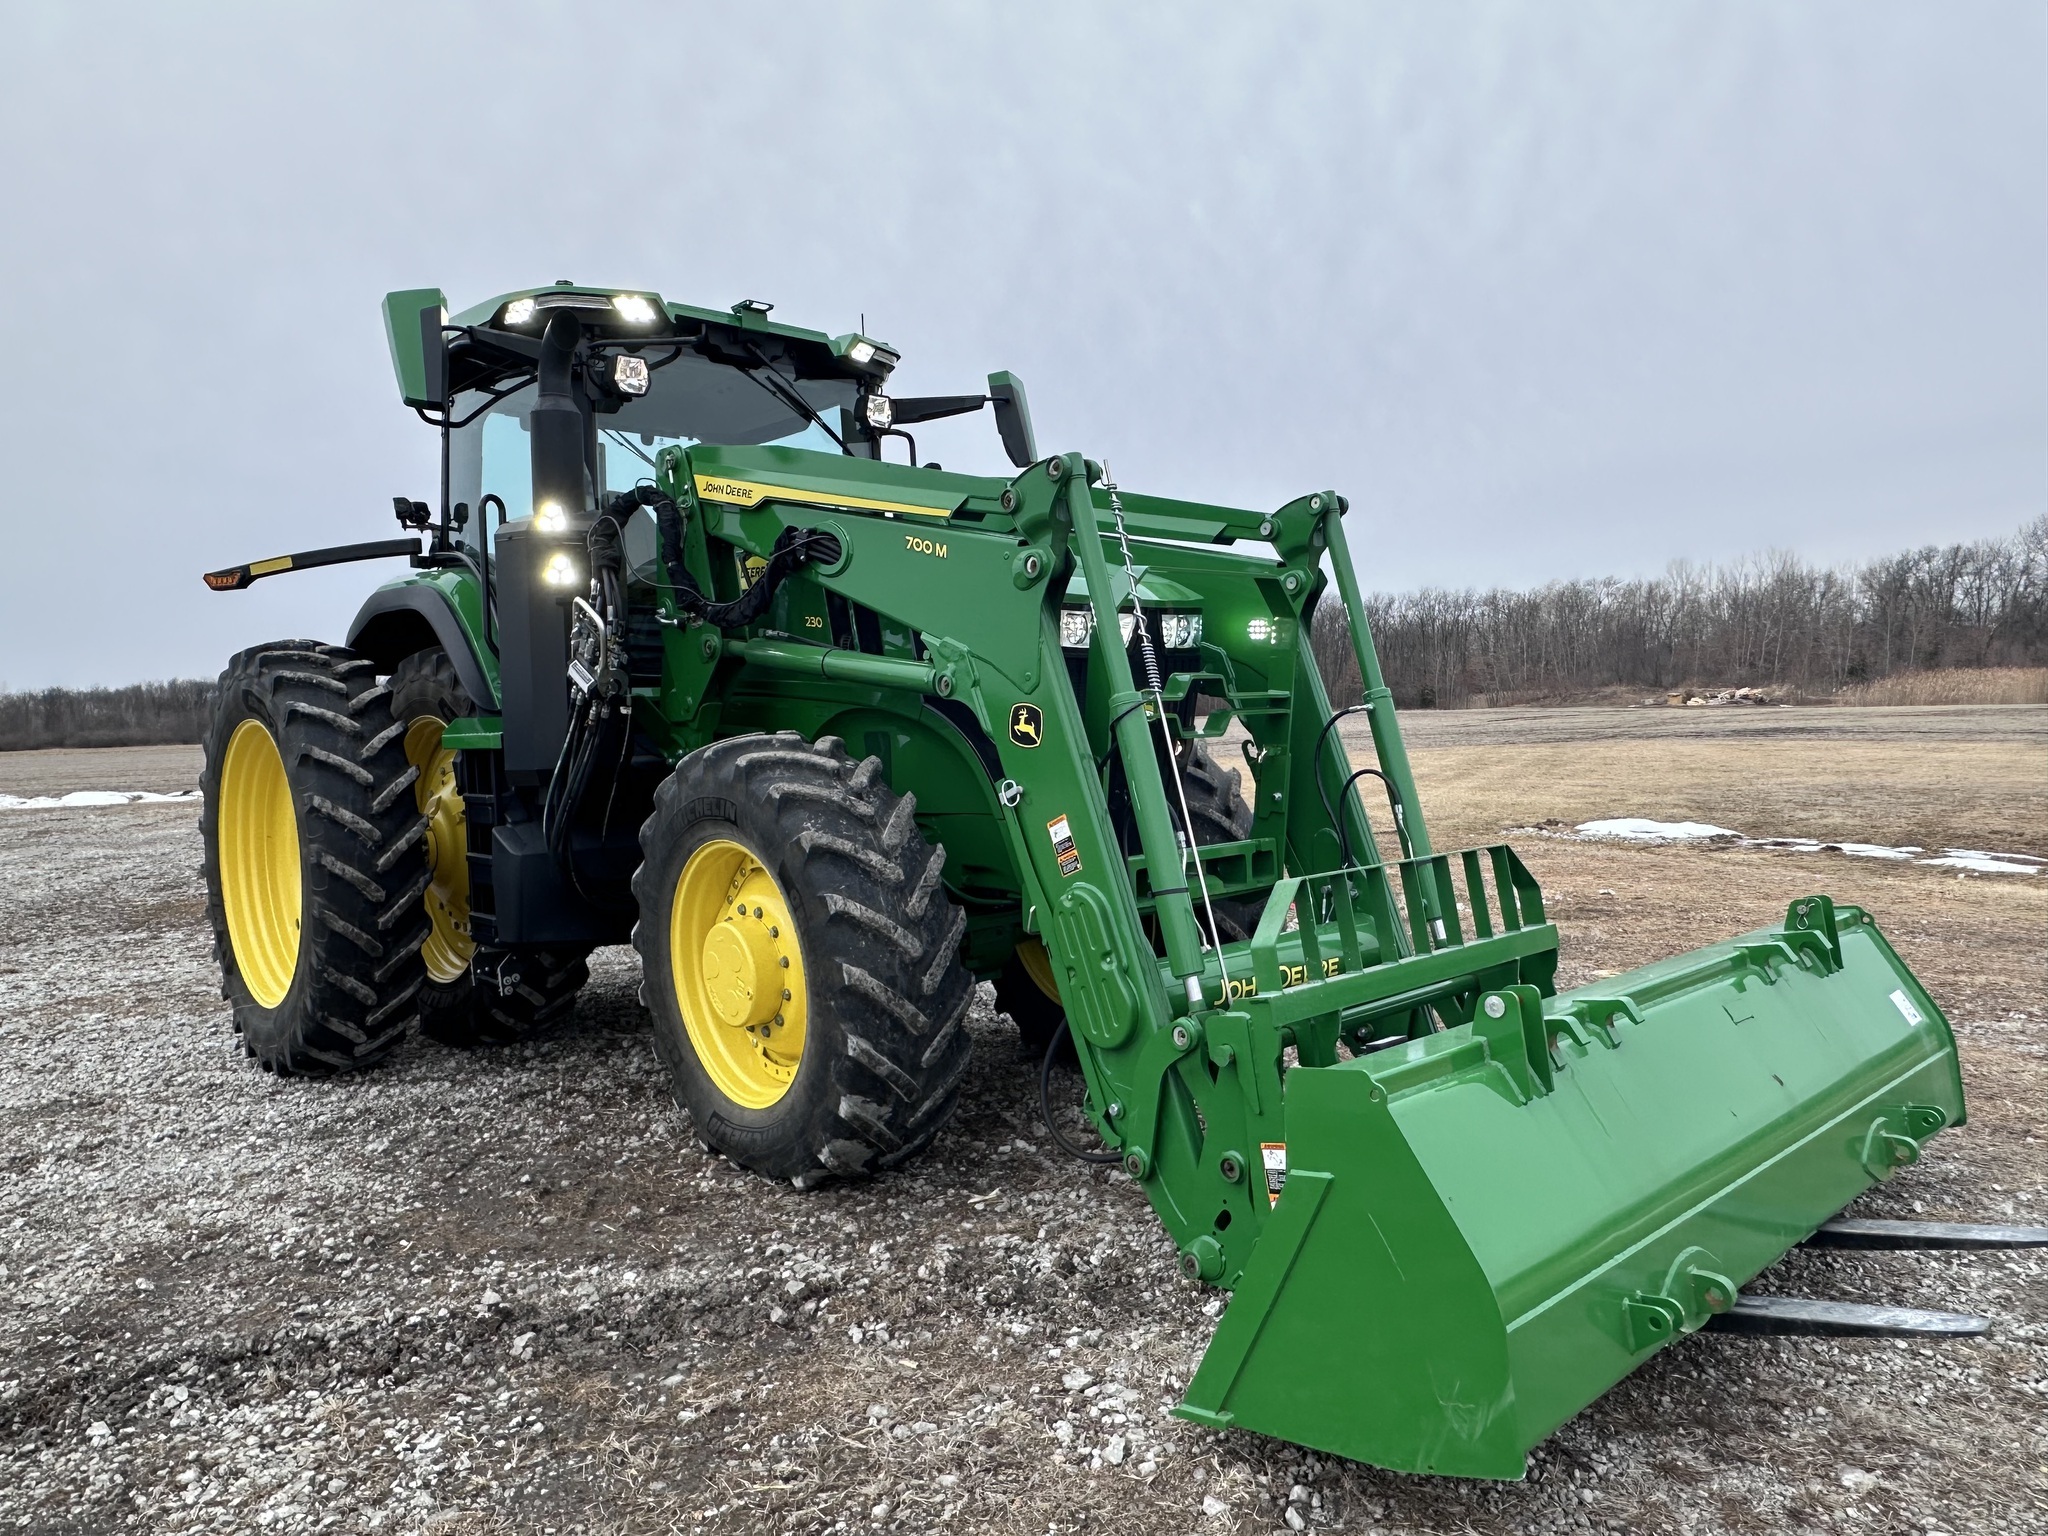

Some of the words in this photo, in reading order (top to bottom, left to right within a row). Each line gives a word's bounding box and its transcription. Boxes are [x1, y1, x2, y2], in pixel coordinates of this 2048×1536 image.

[703, 481, 725, 495] JOHN
[725, 484, 753, 499] DEERE
[905, 535, 933, 555] 700
[935, 542, 948, 559] M
[804, 616, 823, 628] 230
[1213, 976, 1257, 1006] JOH
[1278, 957, 1340, 988] DERE
